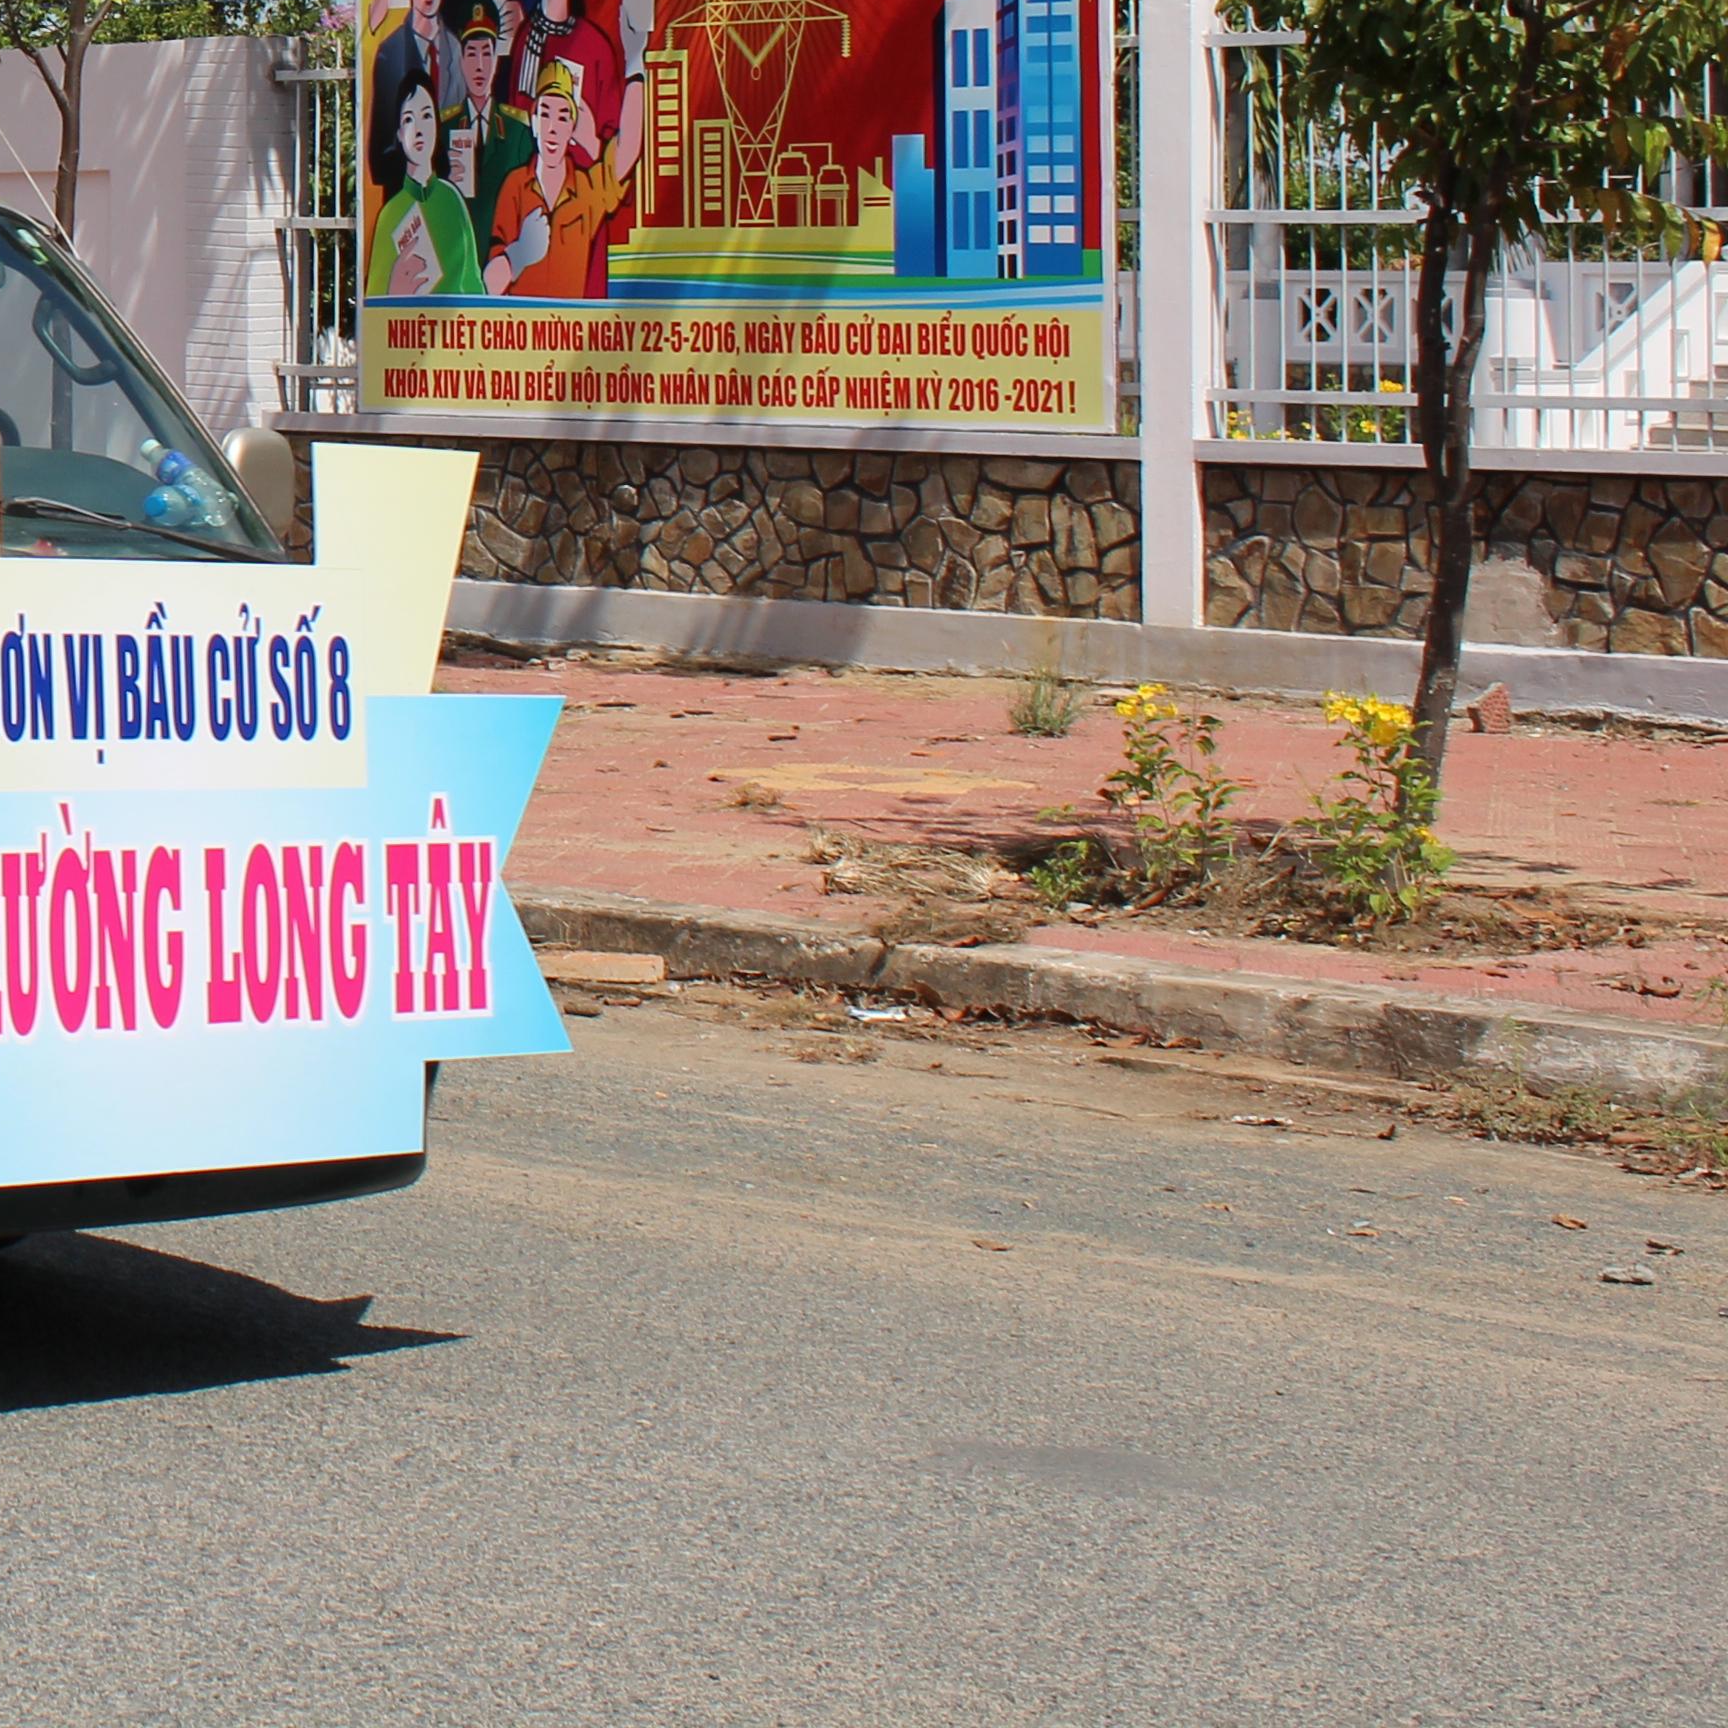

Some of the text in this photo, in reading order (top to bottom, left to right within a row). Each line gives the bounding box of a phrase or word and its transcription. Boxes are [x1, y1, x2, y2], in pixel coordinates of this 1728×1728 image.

[384, 361, 430, 398] KHÓA
[432, 369, 462, 400] XIV
[464, 363, 488, 400] VÀ
[490, 371, 520, 408] ĐẠI
[524, 360, 566, 402] BIỂU
[571, 366, 602, 410] HỘI
[605, 362, 656, 404] ĐỒNG
[659, 367, 710, 406] NHÂN
[714, 367, 754, 406] DÂN
[757, 370, 796, 408] CÁC
[801, 367, 840, 408] CẤP
[845, 370, 912, 416] NHIỆM
[916, 370, 942, 412] KỲ
[388, 311, 1070, 364] NHIỆT LIỆT CHÀO MỪNG NGÀY 22-5-2016, NGÀY BẦU CỬ ĐẠI BIỂU QUỐC HỘI
[63, 633, 112, 764] VỊ
[119, 604, 196, 742] BẦU
[208, 604, 266, 742] CỬ
[271, 606, 320, 742] SỐ
[328, 635, 352, 742] 8
[206, 843, 366, 1024] LONG
[384, 796, 494, 1016] TÂY
